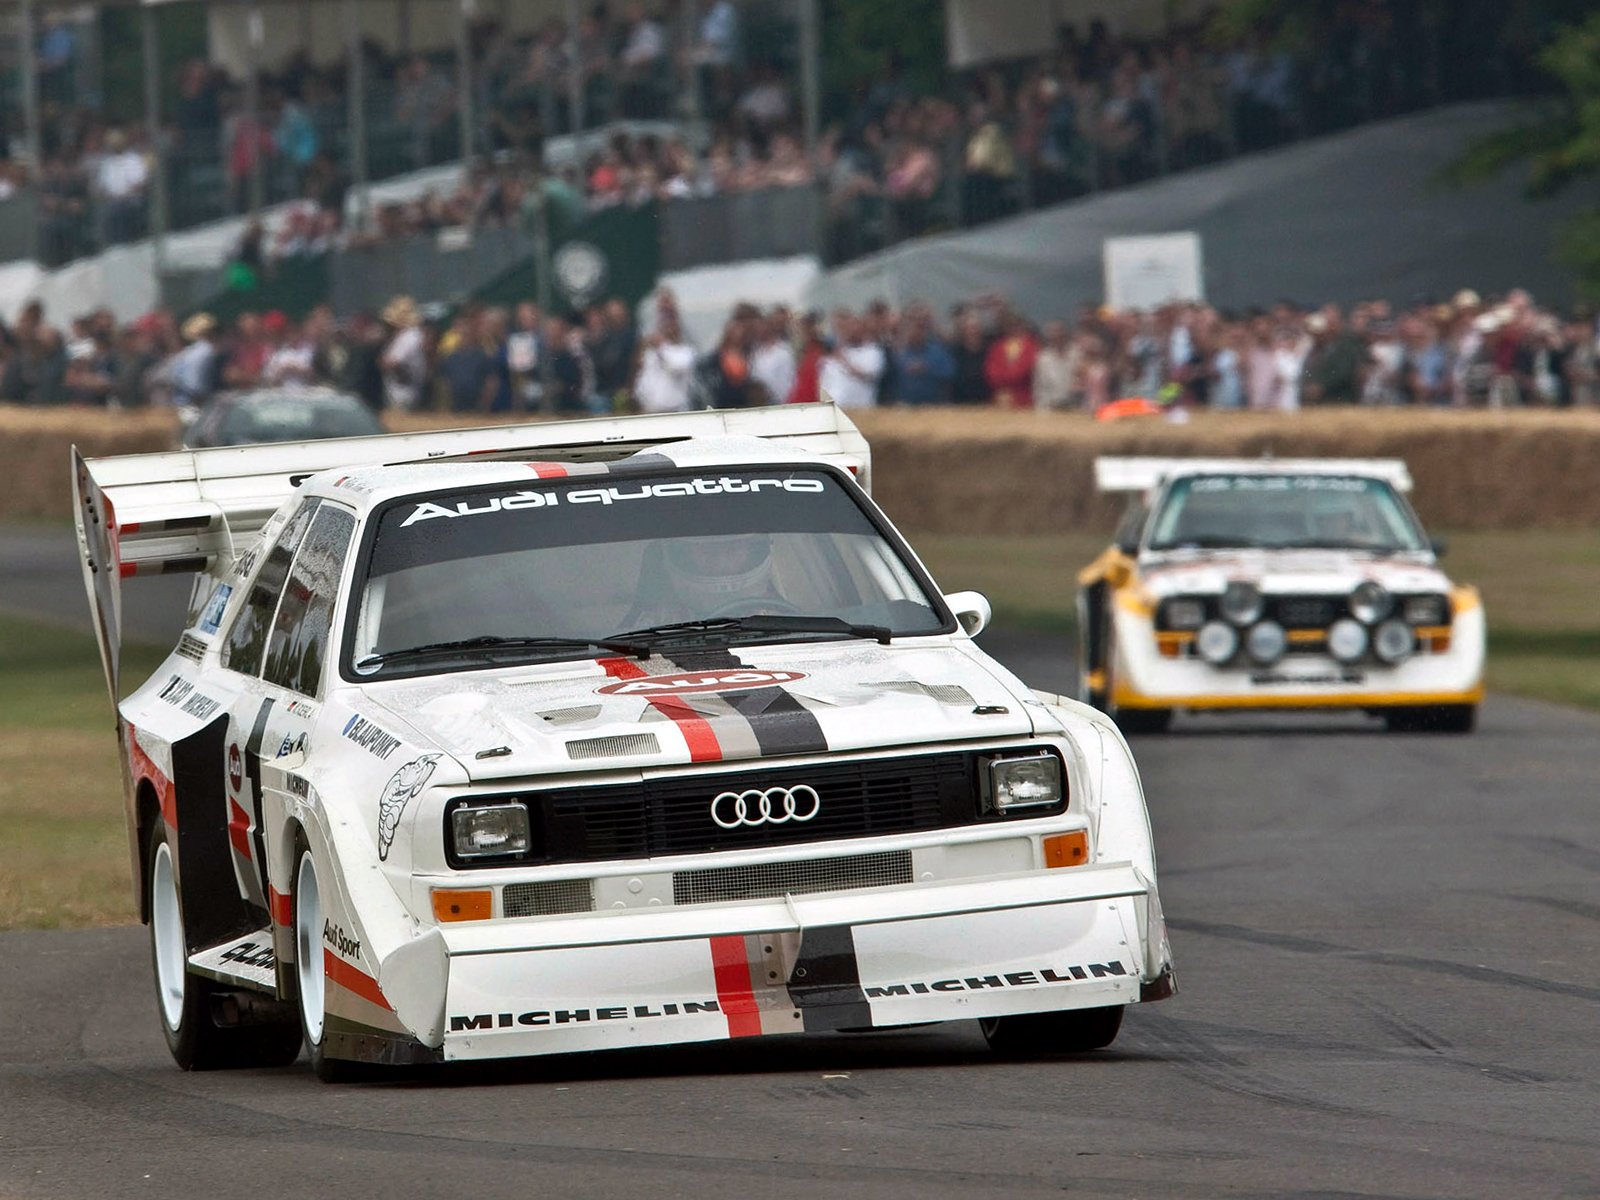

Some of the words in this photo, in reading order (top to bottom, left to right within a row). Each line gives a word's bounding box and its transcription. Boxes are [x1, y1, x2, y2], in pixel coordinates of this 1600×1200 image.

[401, 491, 558, 527] Audi
[568, 477, 824, 504] quattro
[347, 718, 402, 760] BLAUPUNKT
[323, 918, 338, 947] Audi
[338, 928, 360, 960] Sport
[865, 959, 1124, 998] MICHELIN
[450, 1000, 718, 1031] MICHELIN
